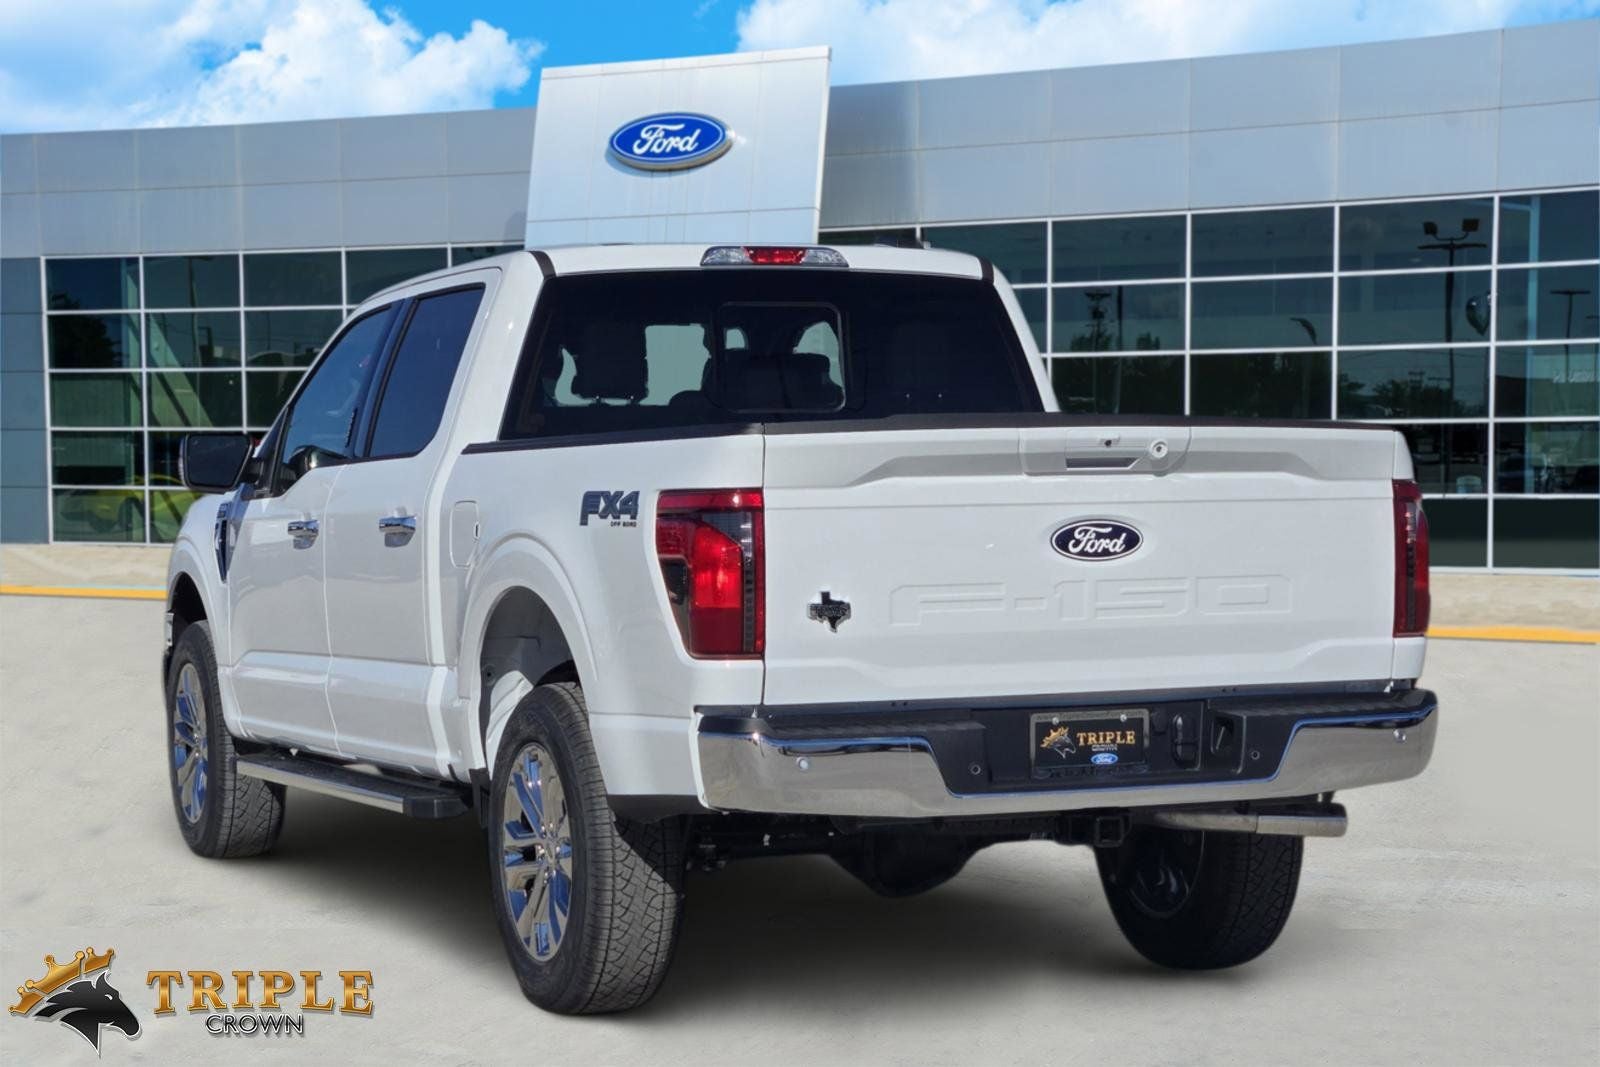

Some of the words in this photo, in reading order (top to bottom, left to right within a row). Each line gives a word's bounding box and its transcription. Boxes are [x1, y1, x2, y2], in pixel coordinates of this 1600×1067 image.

[632, 123, 701, 155] Ford
[579, 490, 640, 526] FX4
[1068, 526, 1127, 553] Ford
[889, 574, 1293, 626] F-150
[1076, 730, 1136, 746] TRIPLE
